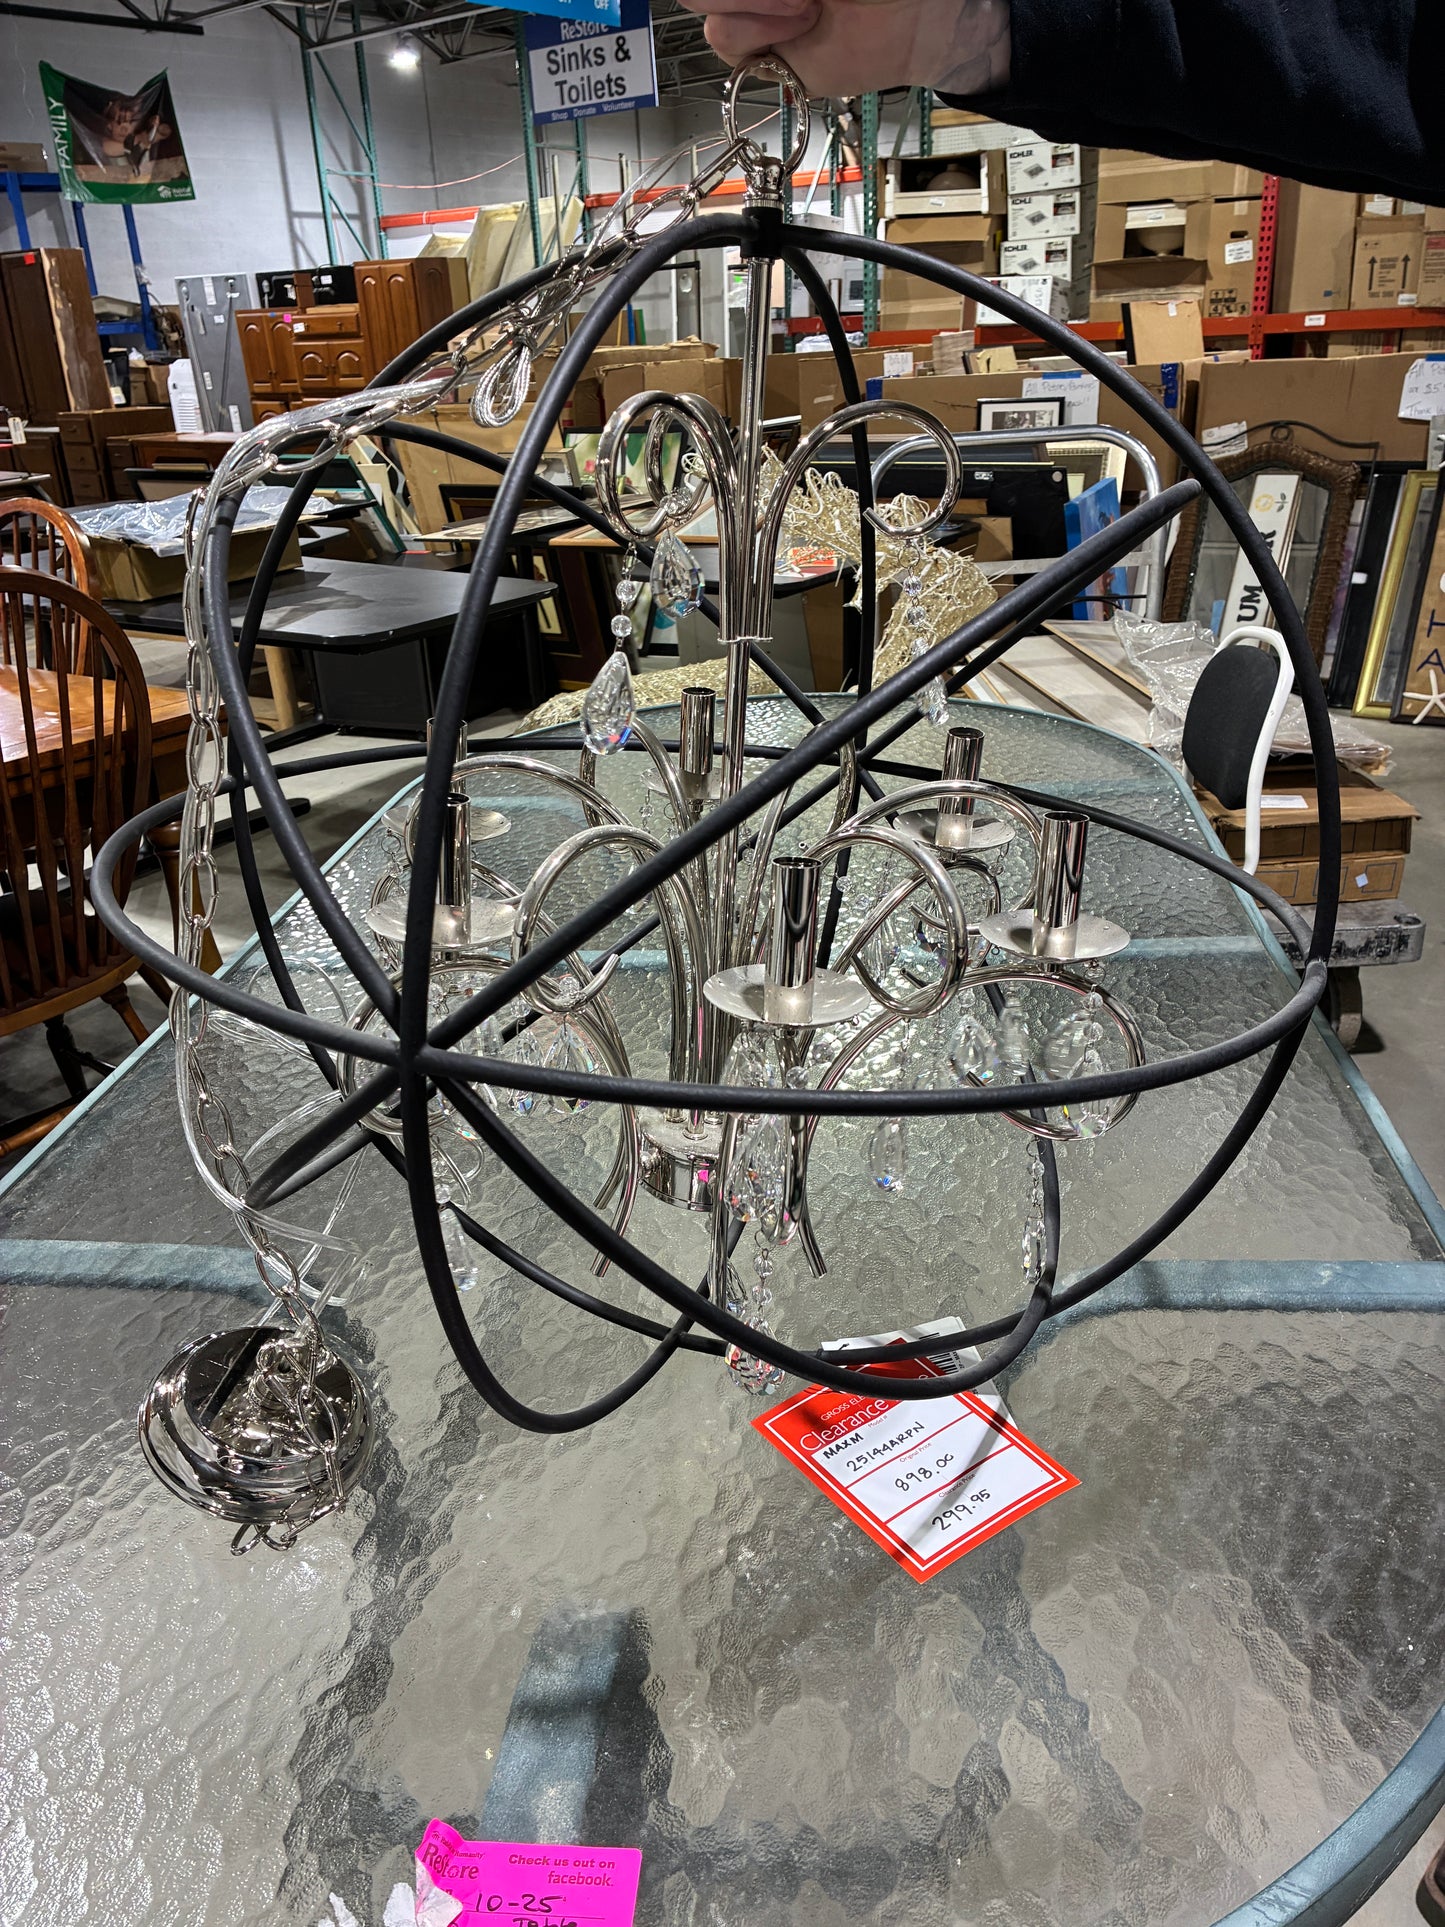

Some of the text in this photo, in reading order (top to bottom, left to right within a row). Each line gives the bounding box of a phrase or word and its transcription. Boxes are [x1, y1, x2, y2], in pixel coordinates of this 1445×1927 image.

[546, 35, 632, 75] Sinks &
[555, 72, 626, 105] Toilets
[573, 106, 597, 117] Donate
[602, 100, 635, 112] Volunteer
[48, 97, 72, 169] FAMILY
[1009, 150, 1033, 159] KOHLER
[1004, 244, 1027, 253] KOHLER
[820, 1402, 850, 1421] GROSS
[800, 1399, 889, 1452] Clearance
[823, 1432, 864, 1460] MAXM
[846, 1421, 925, 1472] 25144ARPN
[899, 1442, 932, 1463] Original Price
[939, 1473, 975, 1498] Clearance Price
[932, 1489, 991, 1531] 299.95
[421, 1843, 479, 1879] ReStore
[508, 1854, 615, 1869] Check us out on
[476, 1893, 562, 1913] 10-25
